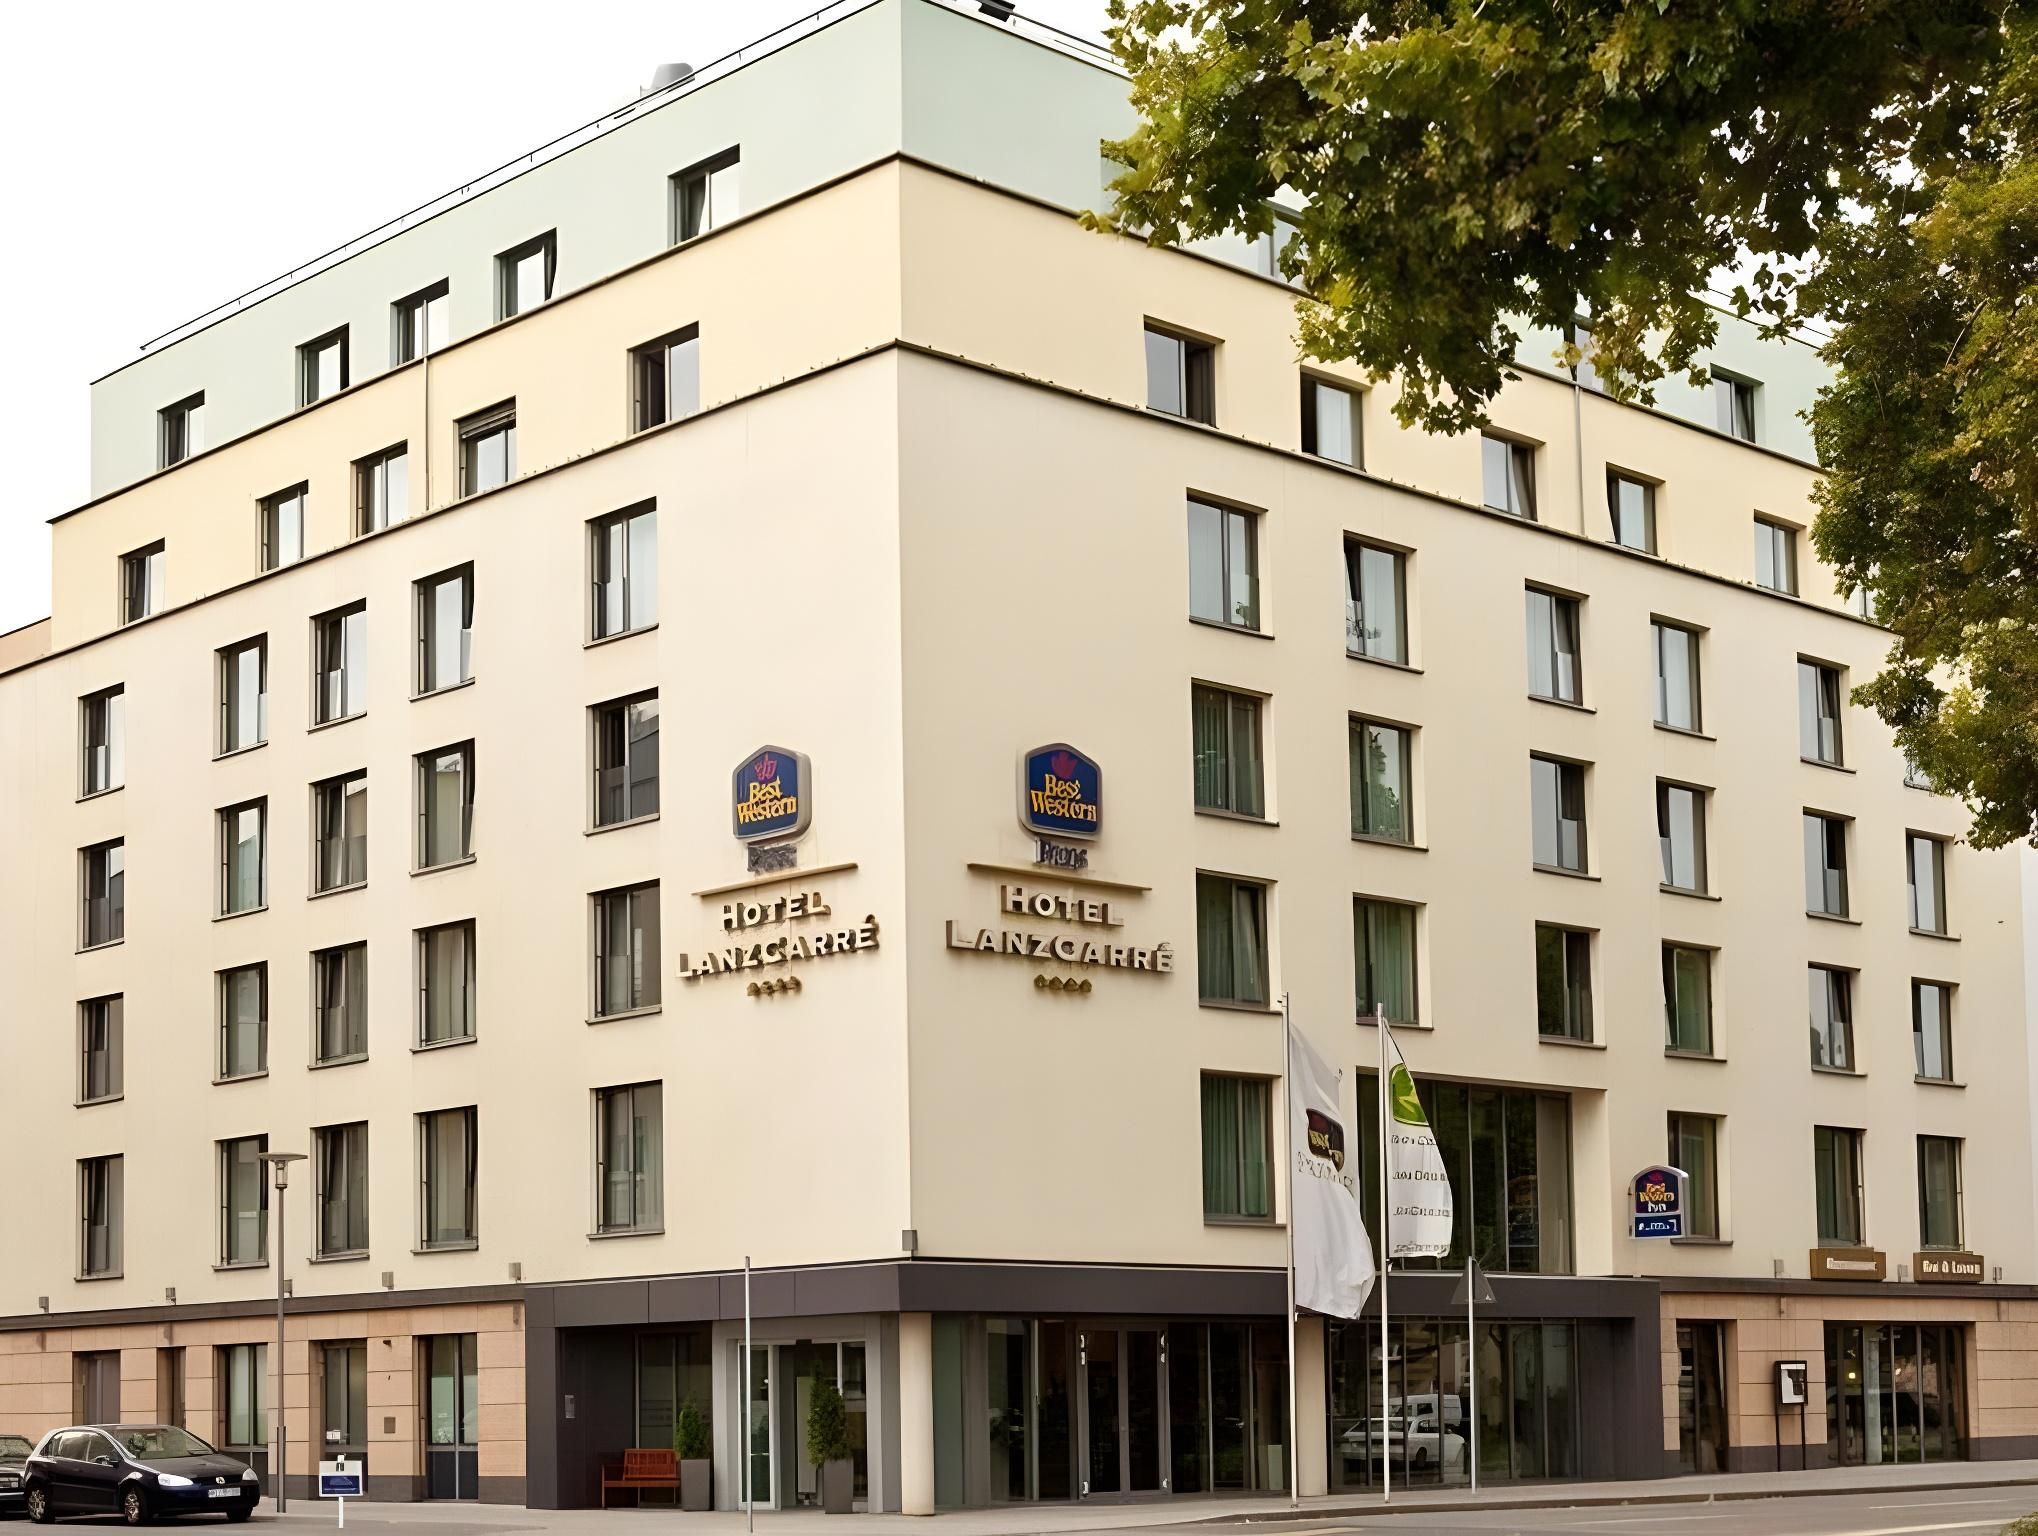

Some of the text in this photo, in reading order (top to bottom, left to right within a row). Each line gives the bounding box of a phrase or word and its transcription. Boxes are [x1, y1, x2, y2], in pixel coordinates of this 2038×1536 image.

[749, 776, 783, 801] Best
[721, 892, 831, 929] HOTEL
[1001, 885, 1124, 926] HOTEL
[676, 914, 880, 977] LANZCARRÉ
[946, 920, 1175, 972] LANZCARRÉ
